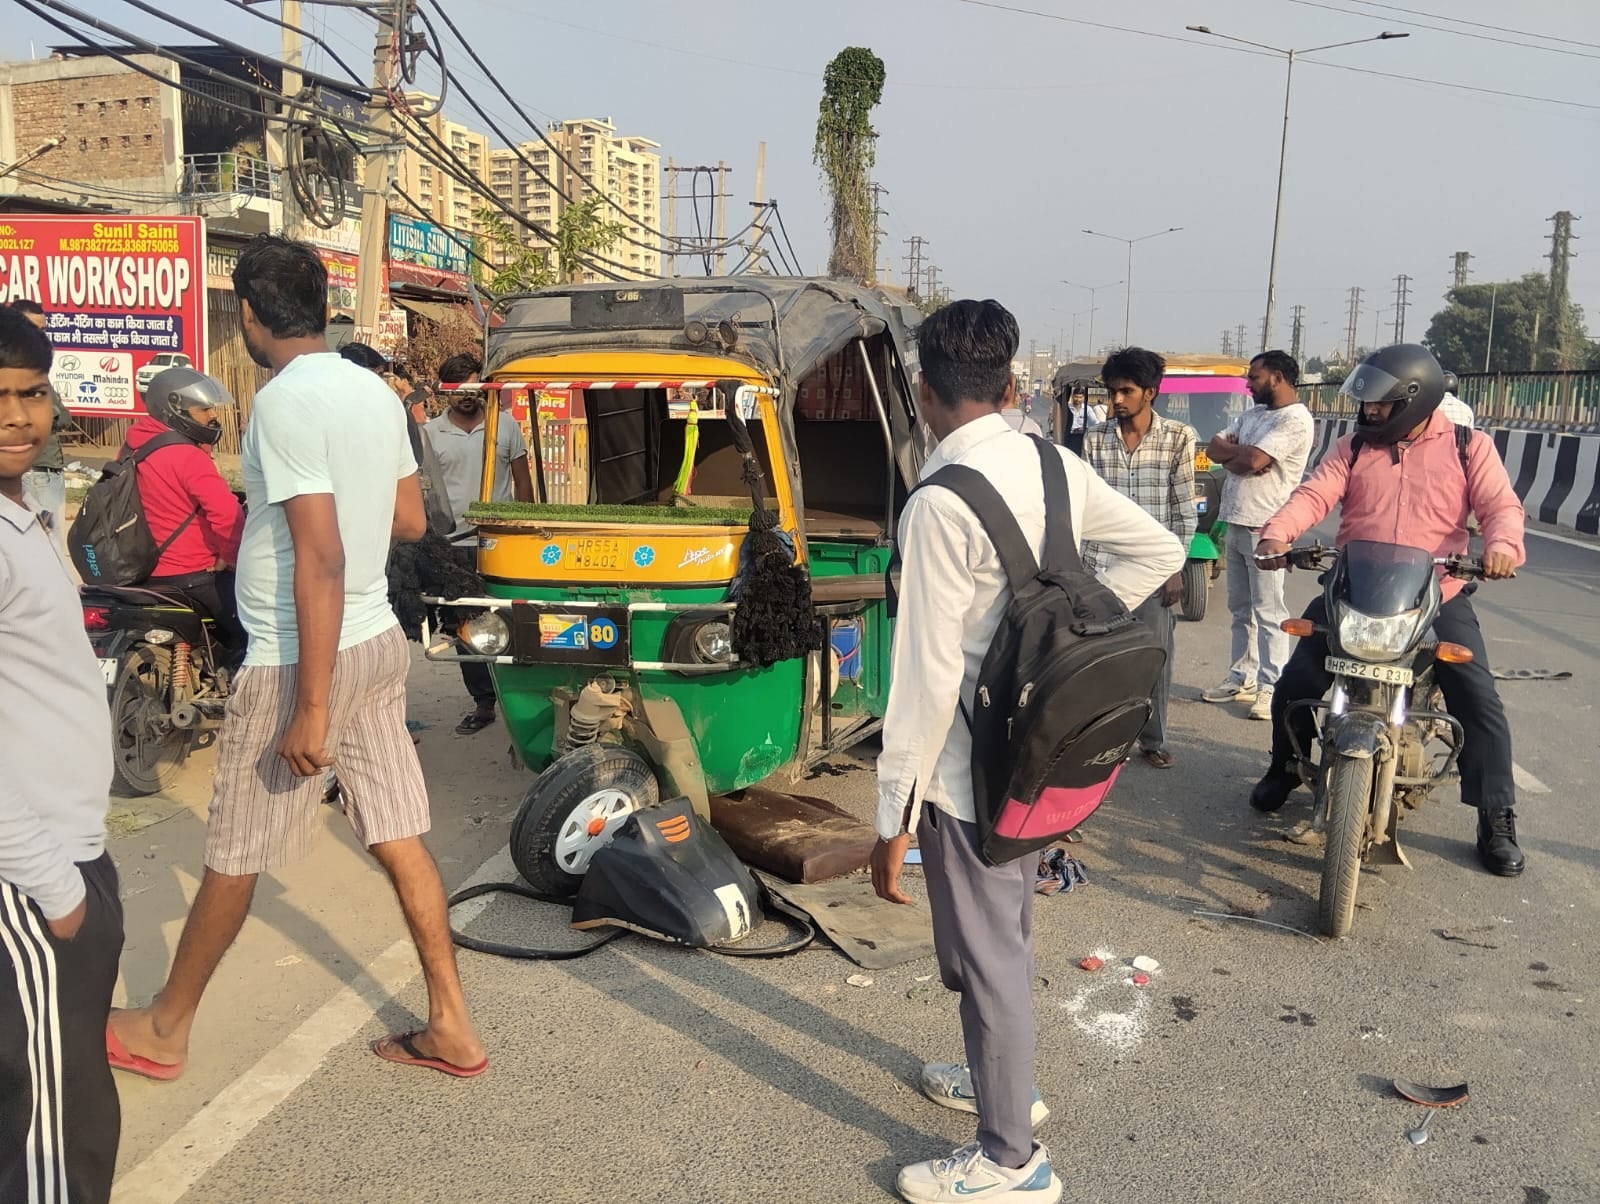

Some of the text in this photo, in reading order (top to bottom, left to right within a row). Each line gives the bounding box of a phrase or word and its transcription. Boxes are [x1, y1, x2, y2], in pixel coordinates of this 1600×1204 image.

[93, 223, 178, 239] Sunil Saini
[46, 255, 190, 308] WORKSHOP
[125, 314, 145, 329] किया
[145, 319, 166, 330] जाता
[166, 316, 174, 332] है
[53, 332, 71, 343] काम
[72, 329, 81, 343] भी
[110, 330, 129, 348] पूर्वक
[130, 331, 150, 345] किया
[150, 335, 170, 346] जाता
[171, 332, 179, 348] है
[92, 374, 129, 384] Mahindra
[82, 544, 102, 577] safari
[590, 625, 614, 643] 80
[1333, 661, 1345, 672] HR
[1351, 663, 1367, 675] 52
[1373, 667, 1380, 678] C
